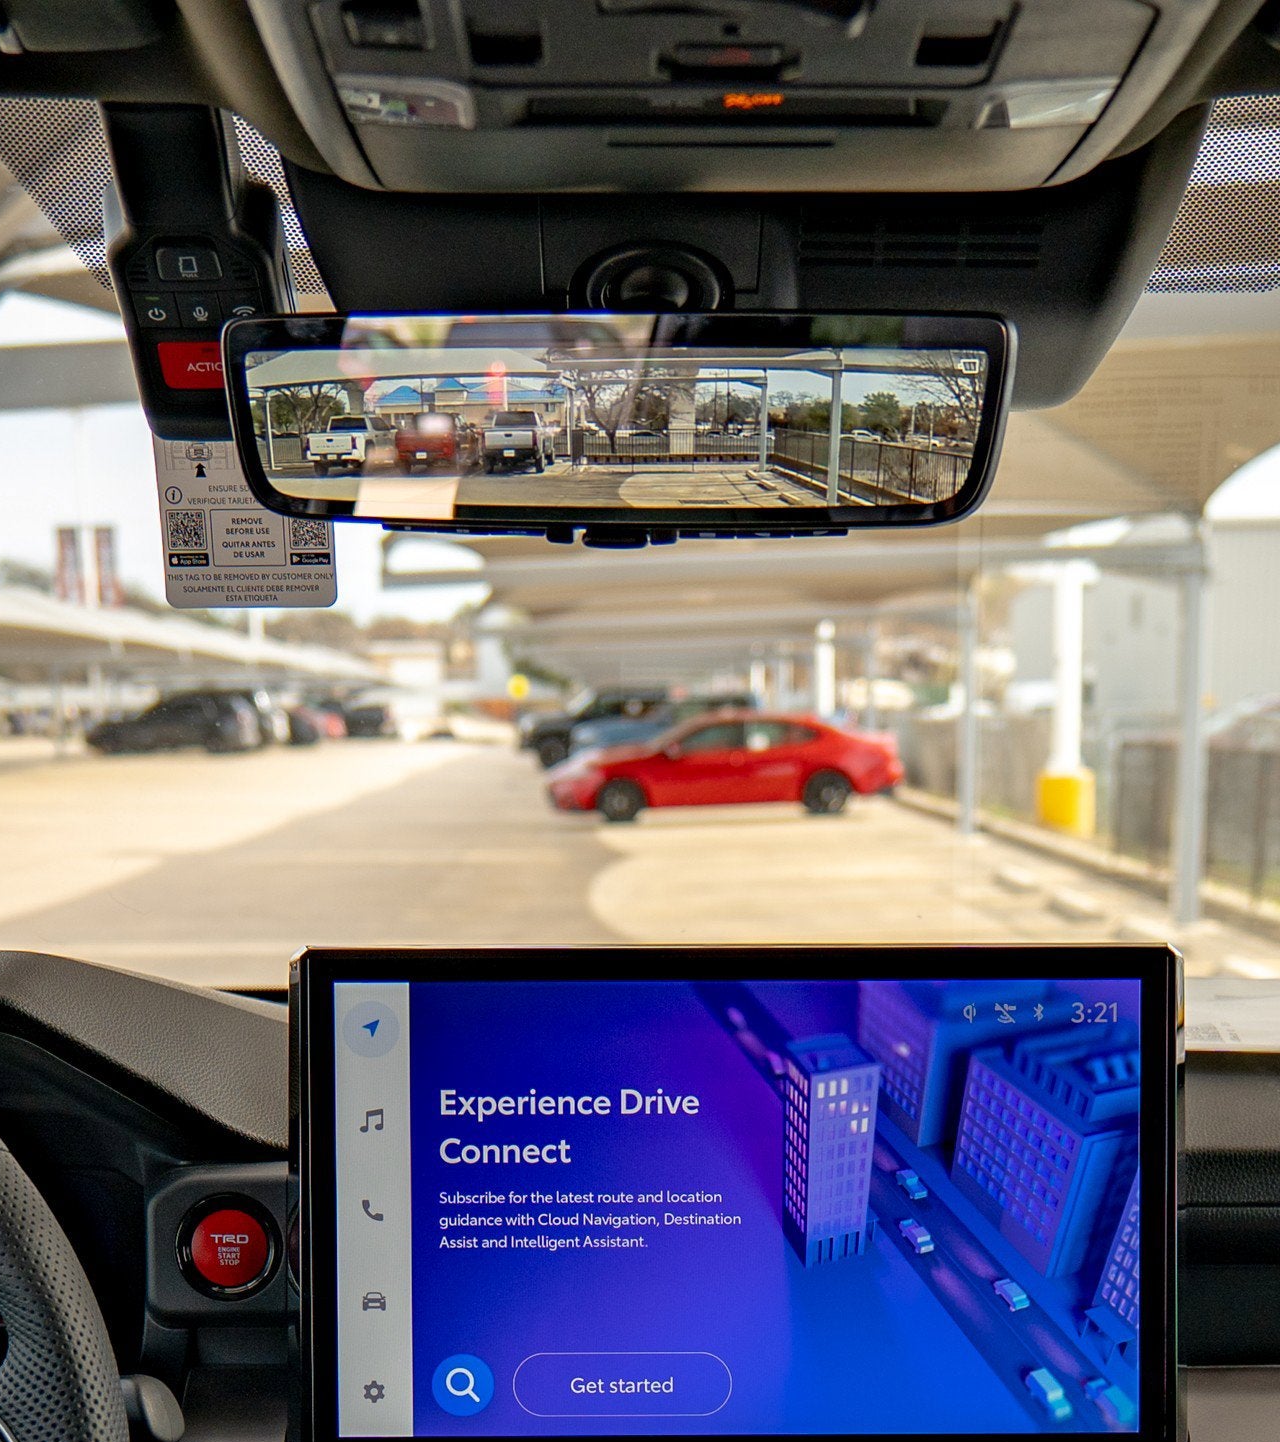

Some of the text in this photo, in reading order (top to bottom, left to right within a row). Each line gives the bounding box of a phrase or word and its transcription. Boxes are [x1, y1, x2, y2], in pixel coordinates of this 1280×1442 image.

[187, 362, 223, 371] ACTIO
[244, 594, 278, 602] ETIQUETA
[1071, 1002, 1118, 1023] 3:21
[439, 1088, 700, 1122] Experience Drive
[439, 1137, 571, 1164] Connect
[439, 1190, 722, 1204] Subscribe for the latest route and location
[439, 1212, 742, 1229] guidance with Cloud Navigation, Destination
[210, 1234, 249, 1244] TRD
[439, 1235, 648, 1251] Assist and Intelligent Assistant.
[570, 1374, 674, 1396] Get started
